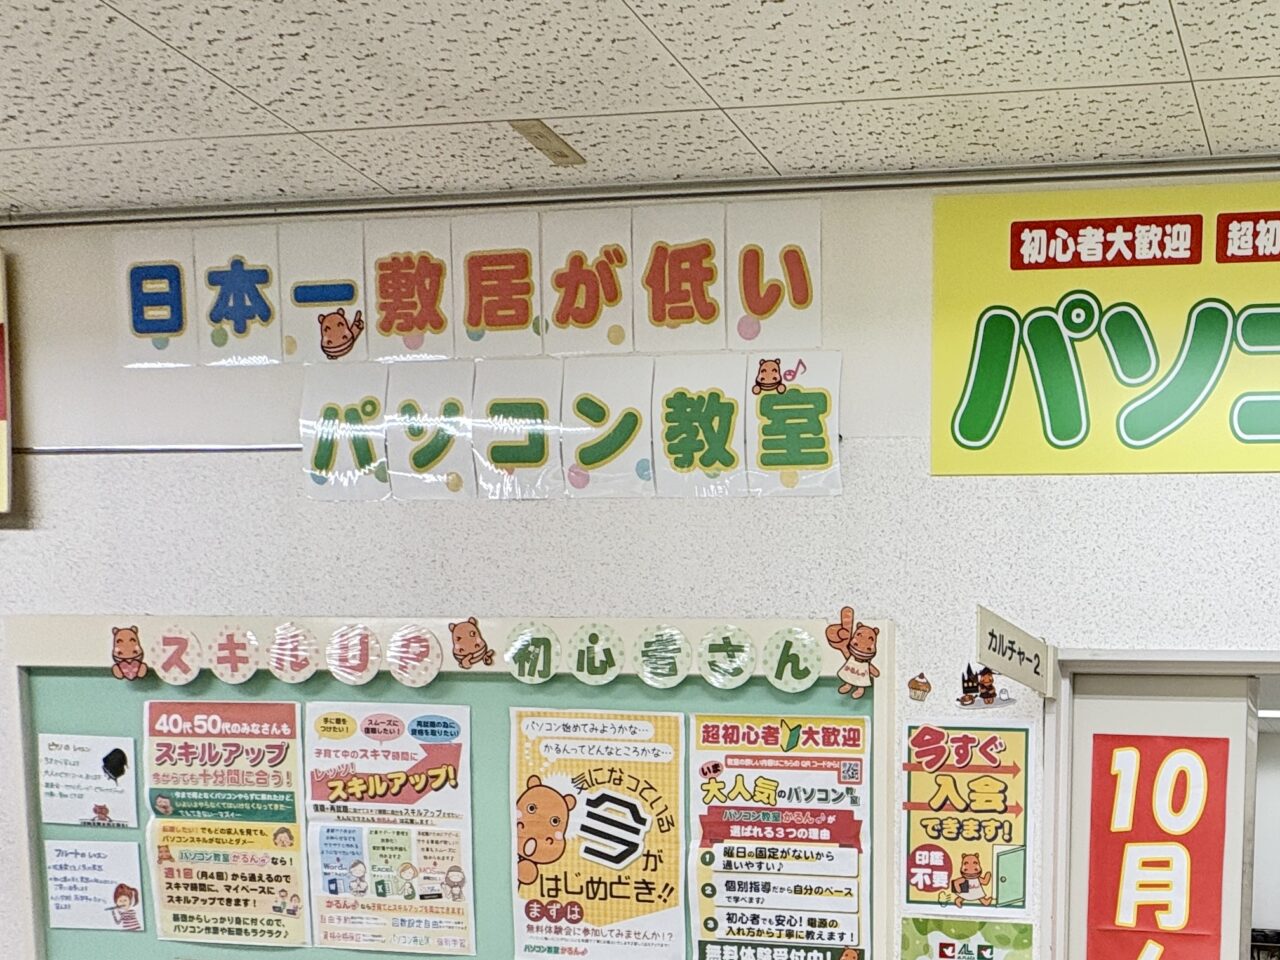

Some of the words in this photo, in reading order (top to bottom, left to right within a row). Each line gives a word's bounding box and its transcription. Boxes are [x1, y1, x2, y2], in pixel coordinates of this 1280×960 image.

[1020, 224, 1193, 263] 初心者大歓迎
[127, 238, 814, 336] 日本一敷居が低い
[311, 387, 834, 471] パソコン教室
[513, 633, 811, 680] 初心者さん
[155, 714, 291, 735] 40代50代のみなさんも
[702, 724, 780, 746] 超初心者
[802, 727, 861, 747] 大歓迎
[155, 742, 289, 767] スキルアップ
[910, 726, 1006, 770] 今すぐ
[930, 775, 1008, 812] 入会
[916, 852, 944, 866] 印鑑
[910, 868, 949, 890] 不要
[529, 902, 581, 920] まずは
